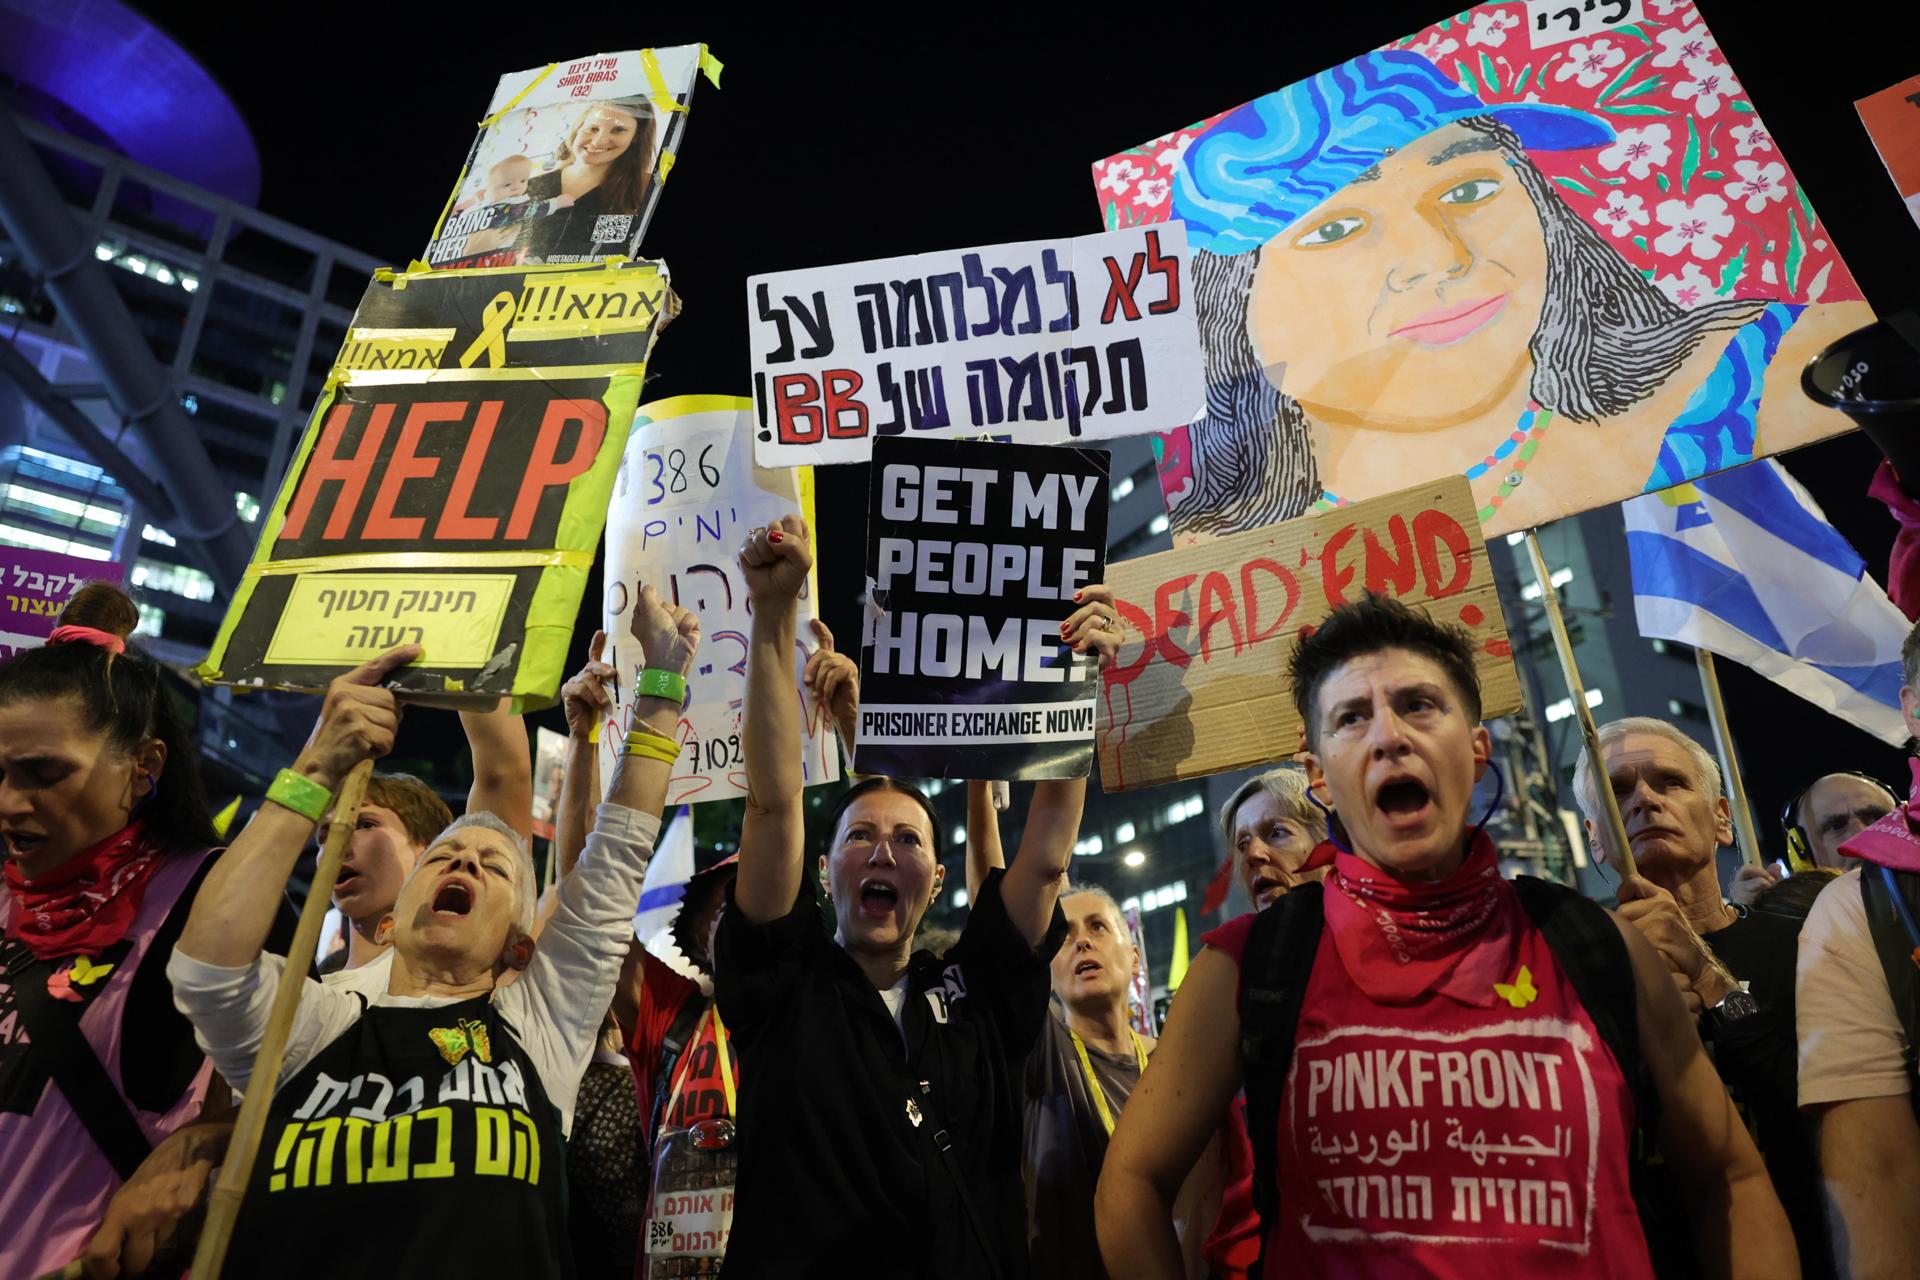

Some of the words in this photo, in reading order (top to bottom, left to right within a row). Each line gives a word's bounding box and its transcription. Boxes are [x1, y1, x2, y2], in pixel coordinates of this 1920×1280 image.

[557, 73, 584, 88] SHIRI
[585, 69, 618, 84] BIBAS
[594, 57, 618, 70] שירי
[571, 84, 593, 98] (32)
[440, 207, 497, 241] BRING
[430, 235, 468, 265] HER
[546, 254, 580, 264] HOSTAGES
[853, 248, 1080, 354] למלחמה
[1100, 230, 1180, 325] לא
[516, 285, 663, 322] אמא!!!
[755, 282, 835, 364] על
[336, 342, 444, 370] אמא!!!
[876, 361, 951, 436] של
[965, 337, 1149, 437] תקומה
[278, 399, 609, 541] HELP
[647, 444, 720, 505] 386
[881, 463, 998, 526] GET
[1010, 471, 1100, 531] MY
[13, 564, 83, 598] לקבל
[877, 537, 1096, 601] PEOPLE
[6, 594, 71, 617] עצור
[318, 589, 390, 618] חטוף
[392, 590, 477, 619] תינוק
[1102, 558, 1302, 685] DEAD
[1320, 509, 1472, 611] END
[862, 711, 949, 738] PRISONER
[951, 711, 1043, 737] EXCHANGE
[1045, 706, 1093, 734] NOW!
[292, 1071, 426, 1123] בבית
[438, 1056, 530, 1114] אתם
[1307, 1047, 1564, 1118] PINKFRONT
[269, 1105, 455, 1193] בעזה!
[474, 1106, 541, 1186] הם
[1309, 1118, 1431, 1168] الوردية
[1445, 1117, 1572, 1168] الجبهة
[664, 1194, 713, 1216] אותם
[1451, 1175, 1574, 1228] החזית
[651, 1221, 674, 1238] 386
